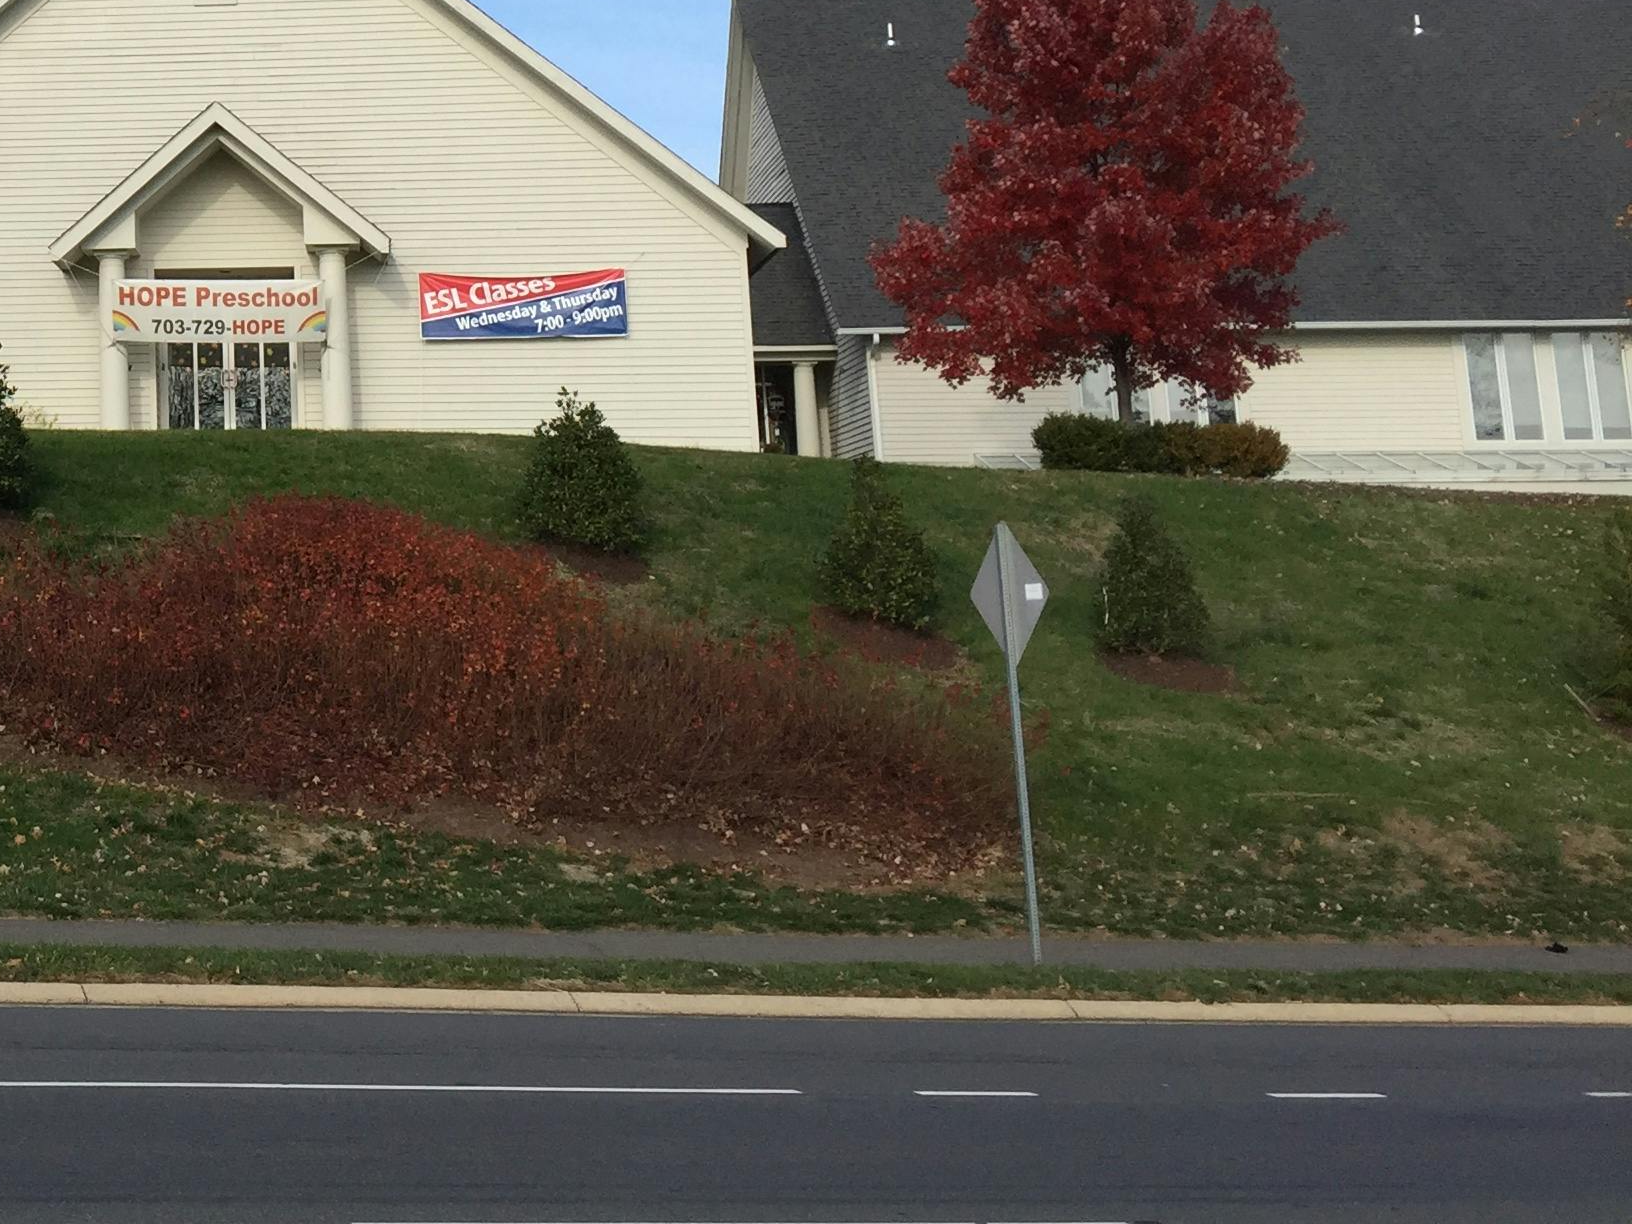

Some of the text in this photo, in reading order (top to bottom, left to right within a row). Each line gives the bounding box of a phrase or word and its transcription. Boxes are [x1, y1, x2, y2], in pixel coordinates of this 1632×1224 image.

[118, 286, 318, 307] HOPE Preschool
[424, 276, 556, 314] ESL Classes
[456, 287, 617, 331] Wednesday & Thursday
[151, 319, 285, 335] 703-729-HOPE
[534, 315, 564, 333] 7:00
[572, 304, 623, 325] 9:00pm
